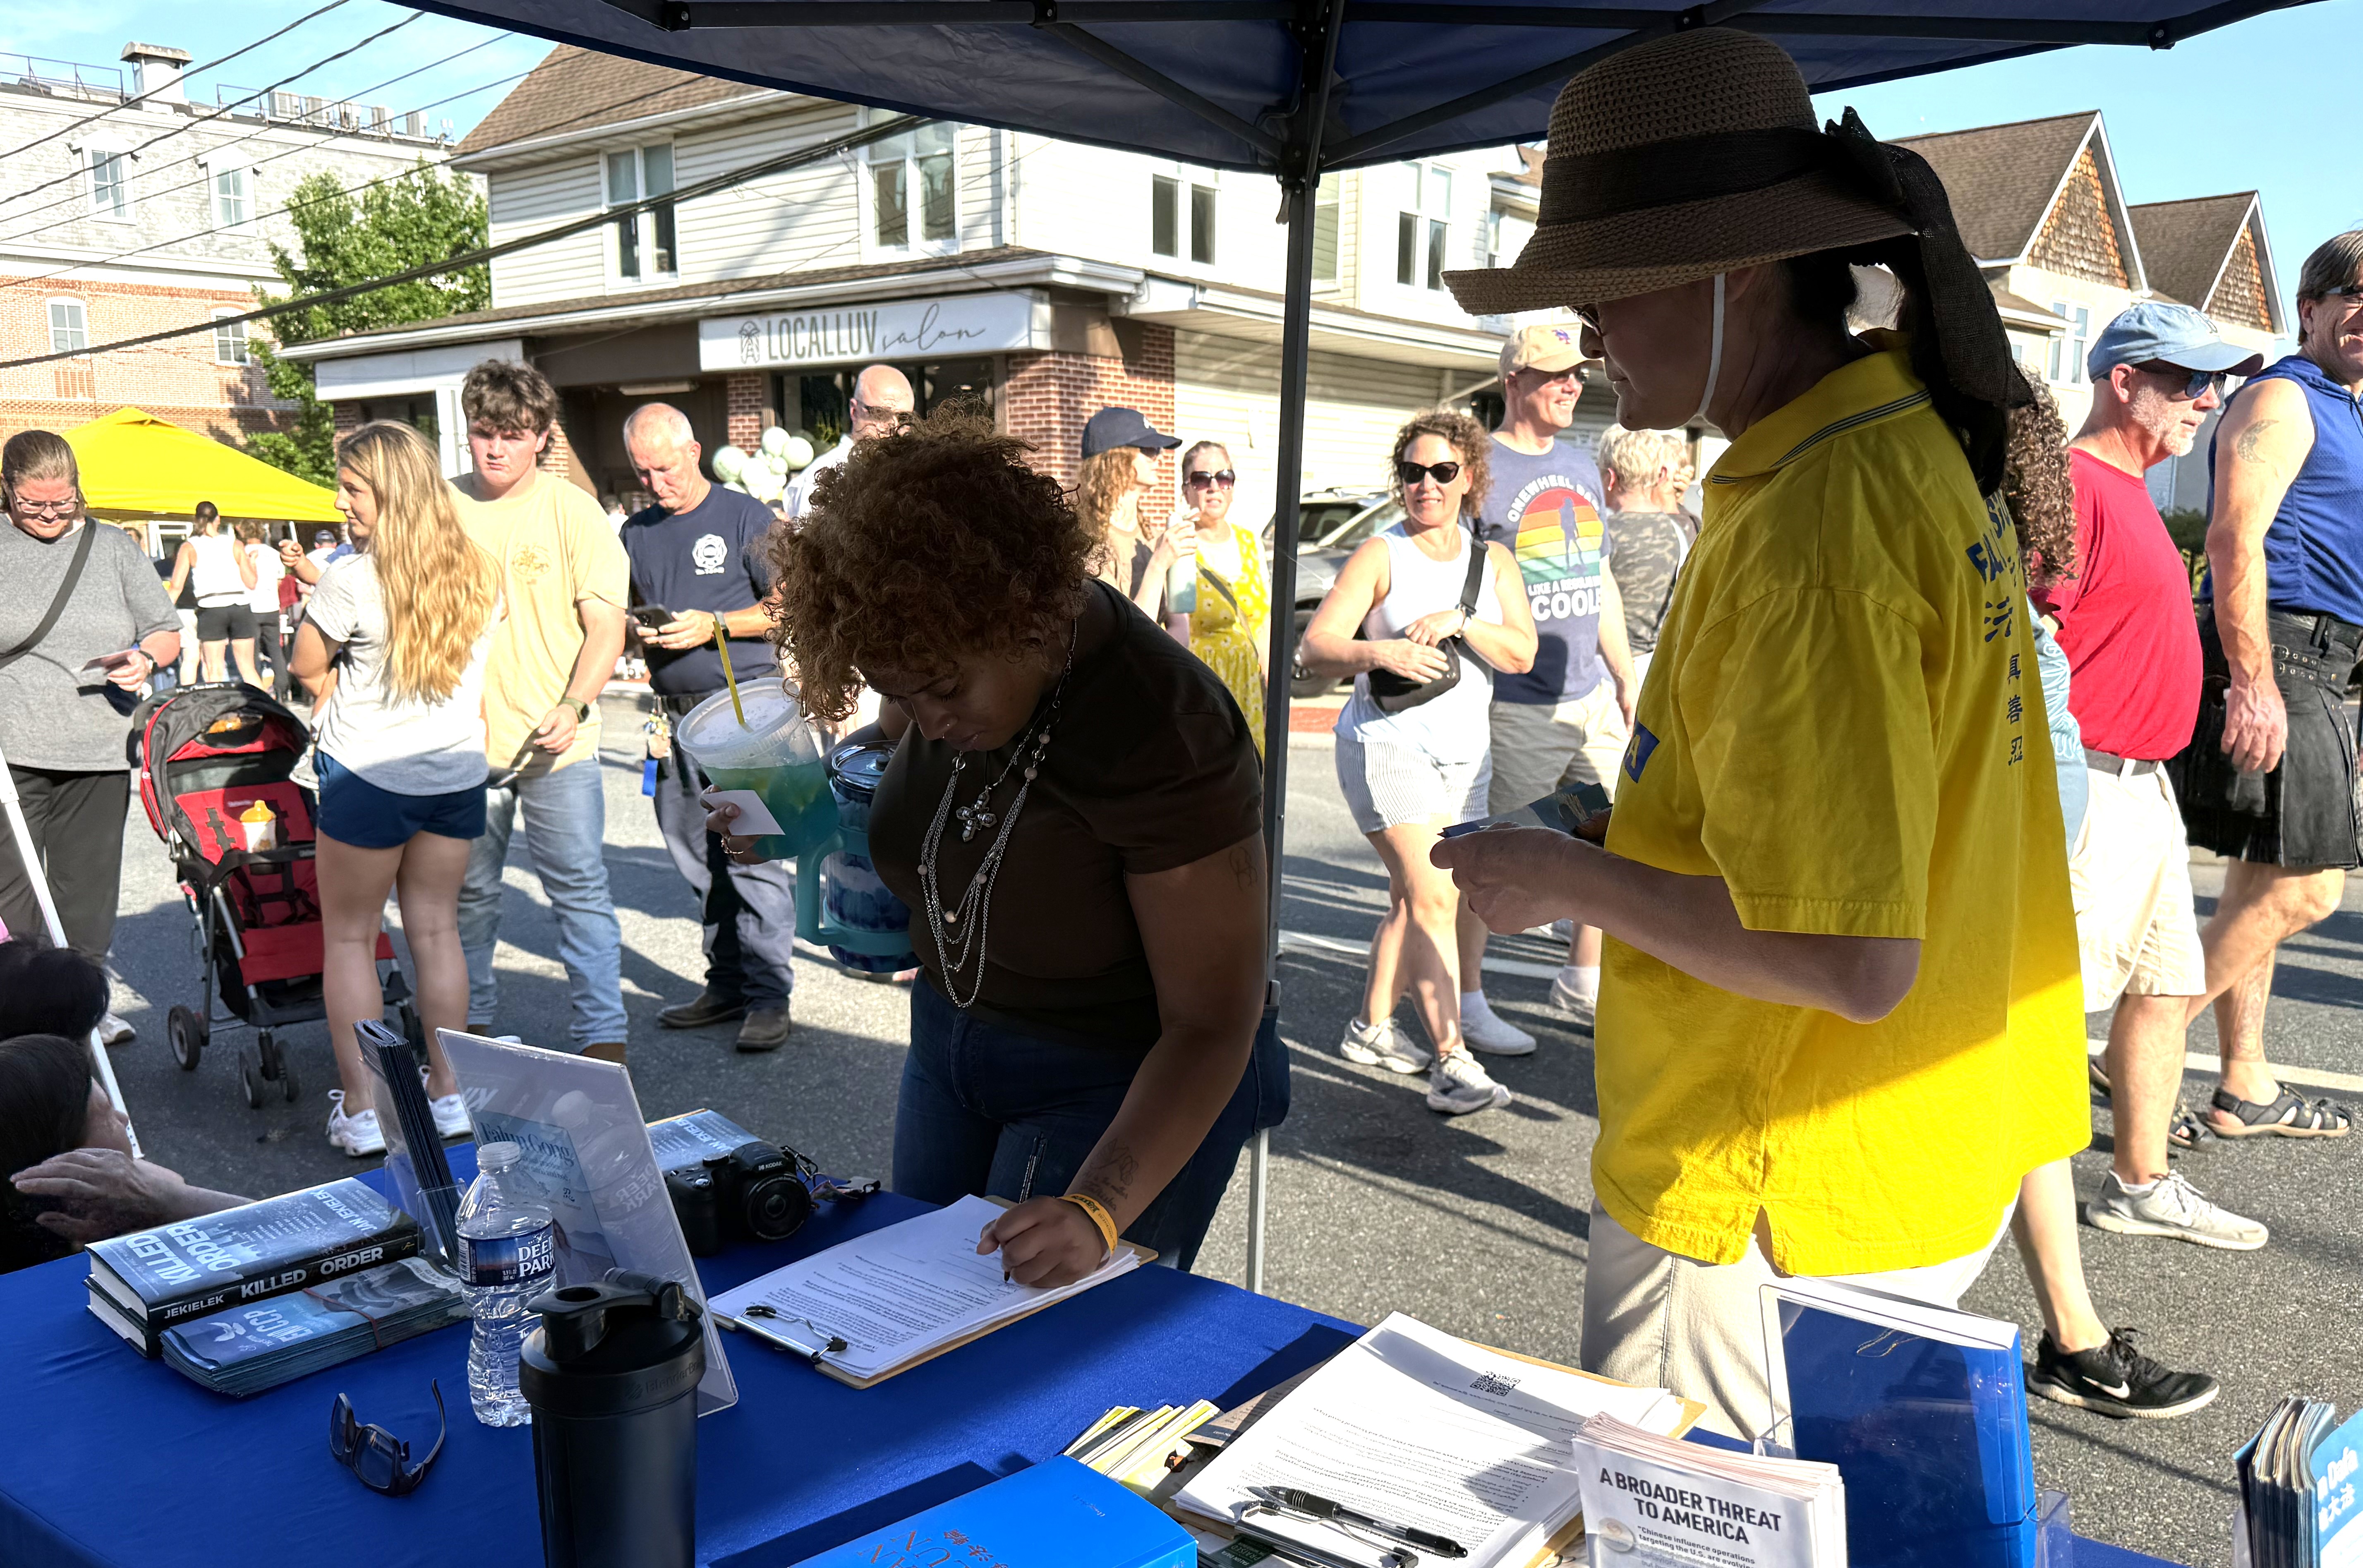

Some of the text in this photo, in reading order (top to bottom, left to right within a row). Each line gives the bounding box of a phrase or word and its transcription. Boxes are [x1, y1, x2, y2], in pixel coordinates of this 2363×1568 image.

[768, 303, 986, 361] LOCALLUV salon
[1507, 475, 1574, 522] ONEWHEEL
[1528, 582, 1551, 596] LIKE
[1552, 580, 1560, 593] A
[1531, 588, 1601, 621] COOLE
[480, 1122, 574, 1167] Falun Gong
[765, 1160, 783, 1170] KODAK
[310, 1189, 378, 1232] JAN JEKIELEK
[125, 1234, 201, 1286] KILLED
[166, 1224, 242, 1272] ORDER
[518, 1235, 553, 1262] DEER
[519, 1249, 555, 1278] PARK
[164, 1247, 383, 1319] JEKIELEK KILLED ORDER
[243, 1309, 289, 1332] CCP
[646, 1361, 699, 1393] BlenderBo
[2327, 1446, 2358, 1489] Dafa
[1600, 1468, 1781, 1532] A BROADER THREAT
[1634, 1497, 1750, 1544] TO AMERICA
[1231, 1545, 1262, 1561] PRAISED
[1639, 1534, 1675, 1550] targeting
[1675, 1544, 1689, 1554] the
[1690, 1549, 1706, 1558] U.S.
[1707, 1554, 1721, 1563] are
[1673, 1536, 1710, 1552] influence
[1712, 1547, 1755, 1564] operations
